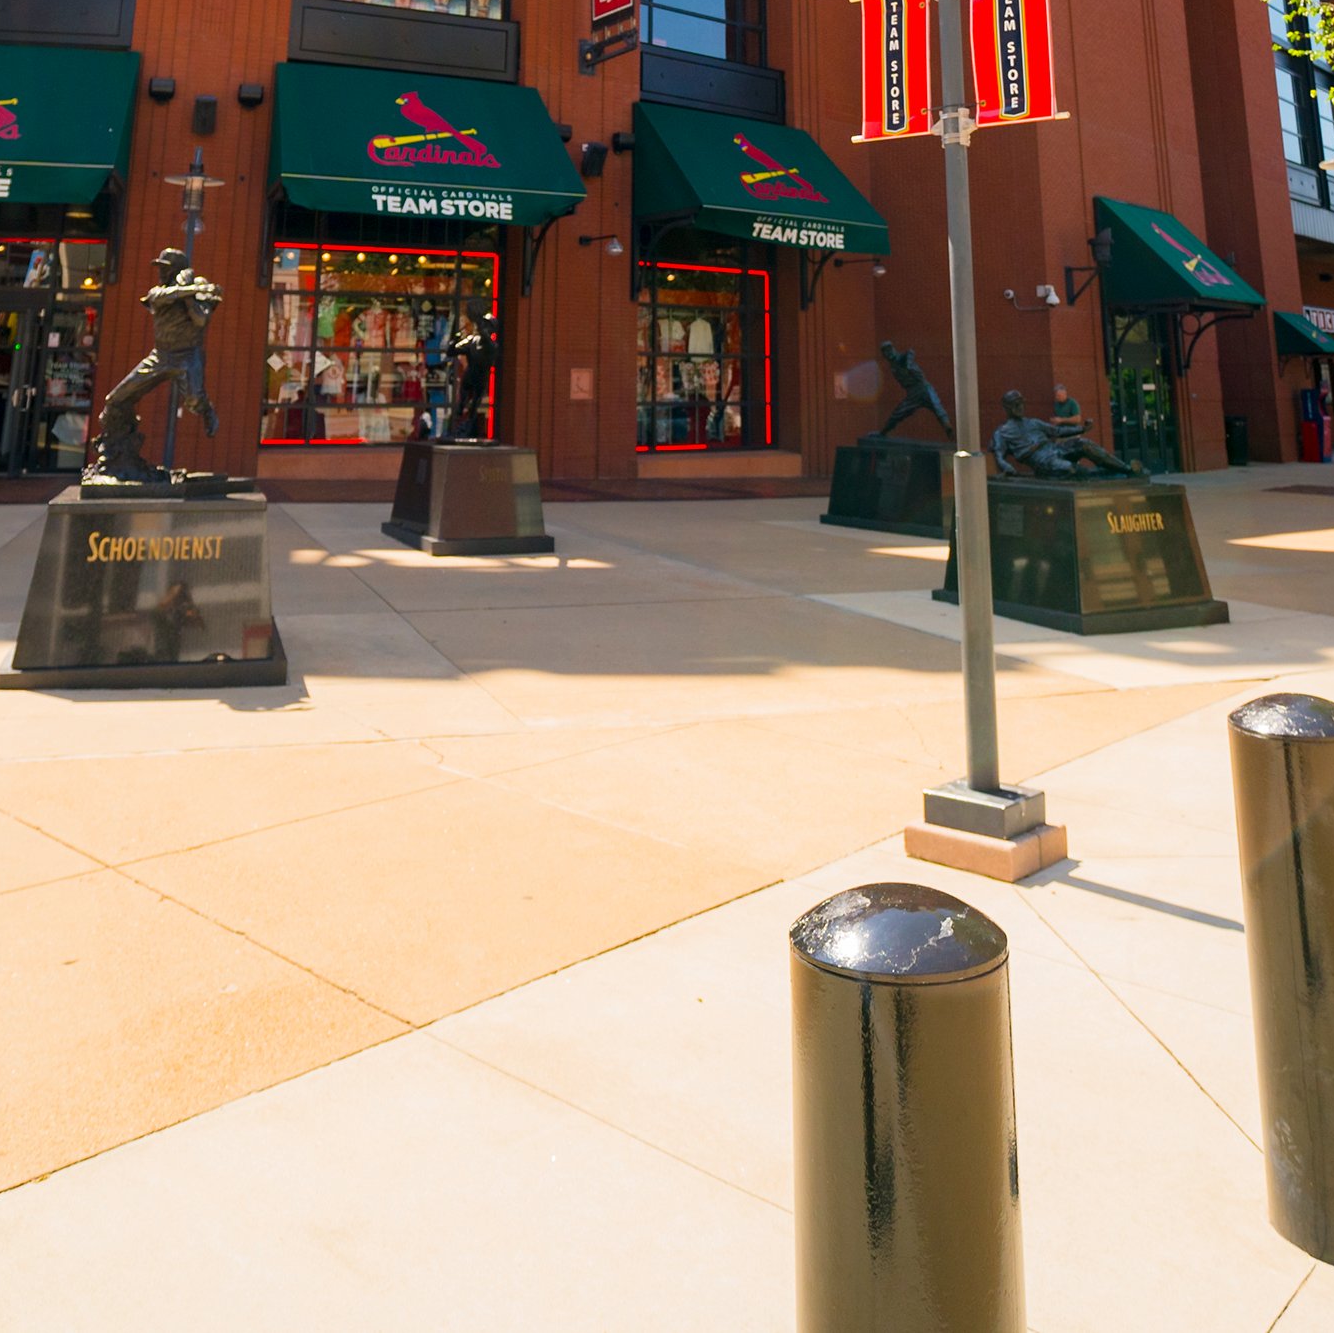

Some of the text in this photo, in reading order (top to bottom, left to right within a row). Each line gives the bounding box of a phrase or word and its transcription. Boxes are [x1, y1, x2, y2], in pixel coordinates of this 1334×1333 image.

[889, 1, 900, 125] TEAM STORE
[1007, 41, 1020, 109] STORE
[367, 134, 501, 169] Cardinals
[371, 185, 513, 202] OFFICIAL CARDINALS
[372, 194, 513, 221] TEAM STORE
[752, 222, 845, 251] TEAM STORE
[756, 216, 845, 232] OFFICIAL CARDINALS
